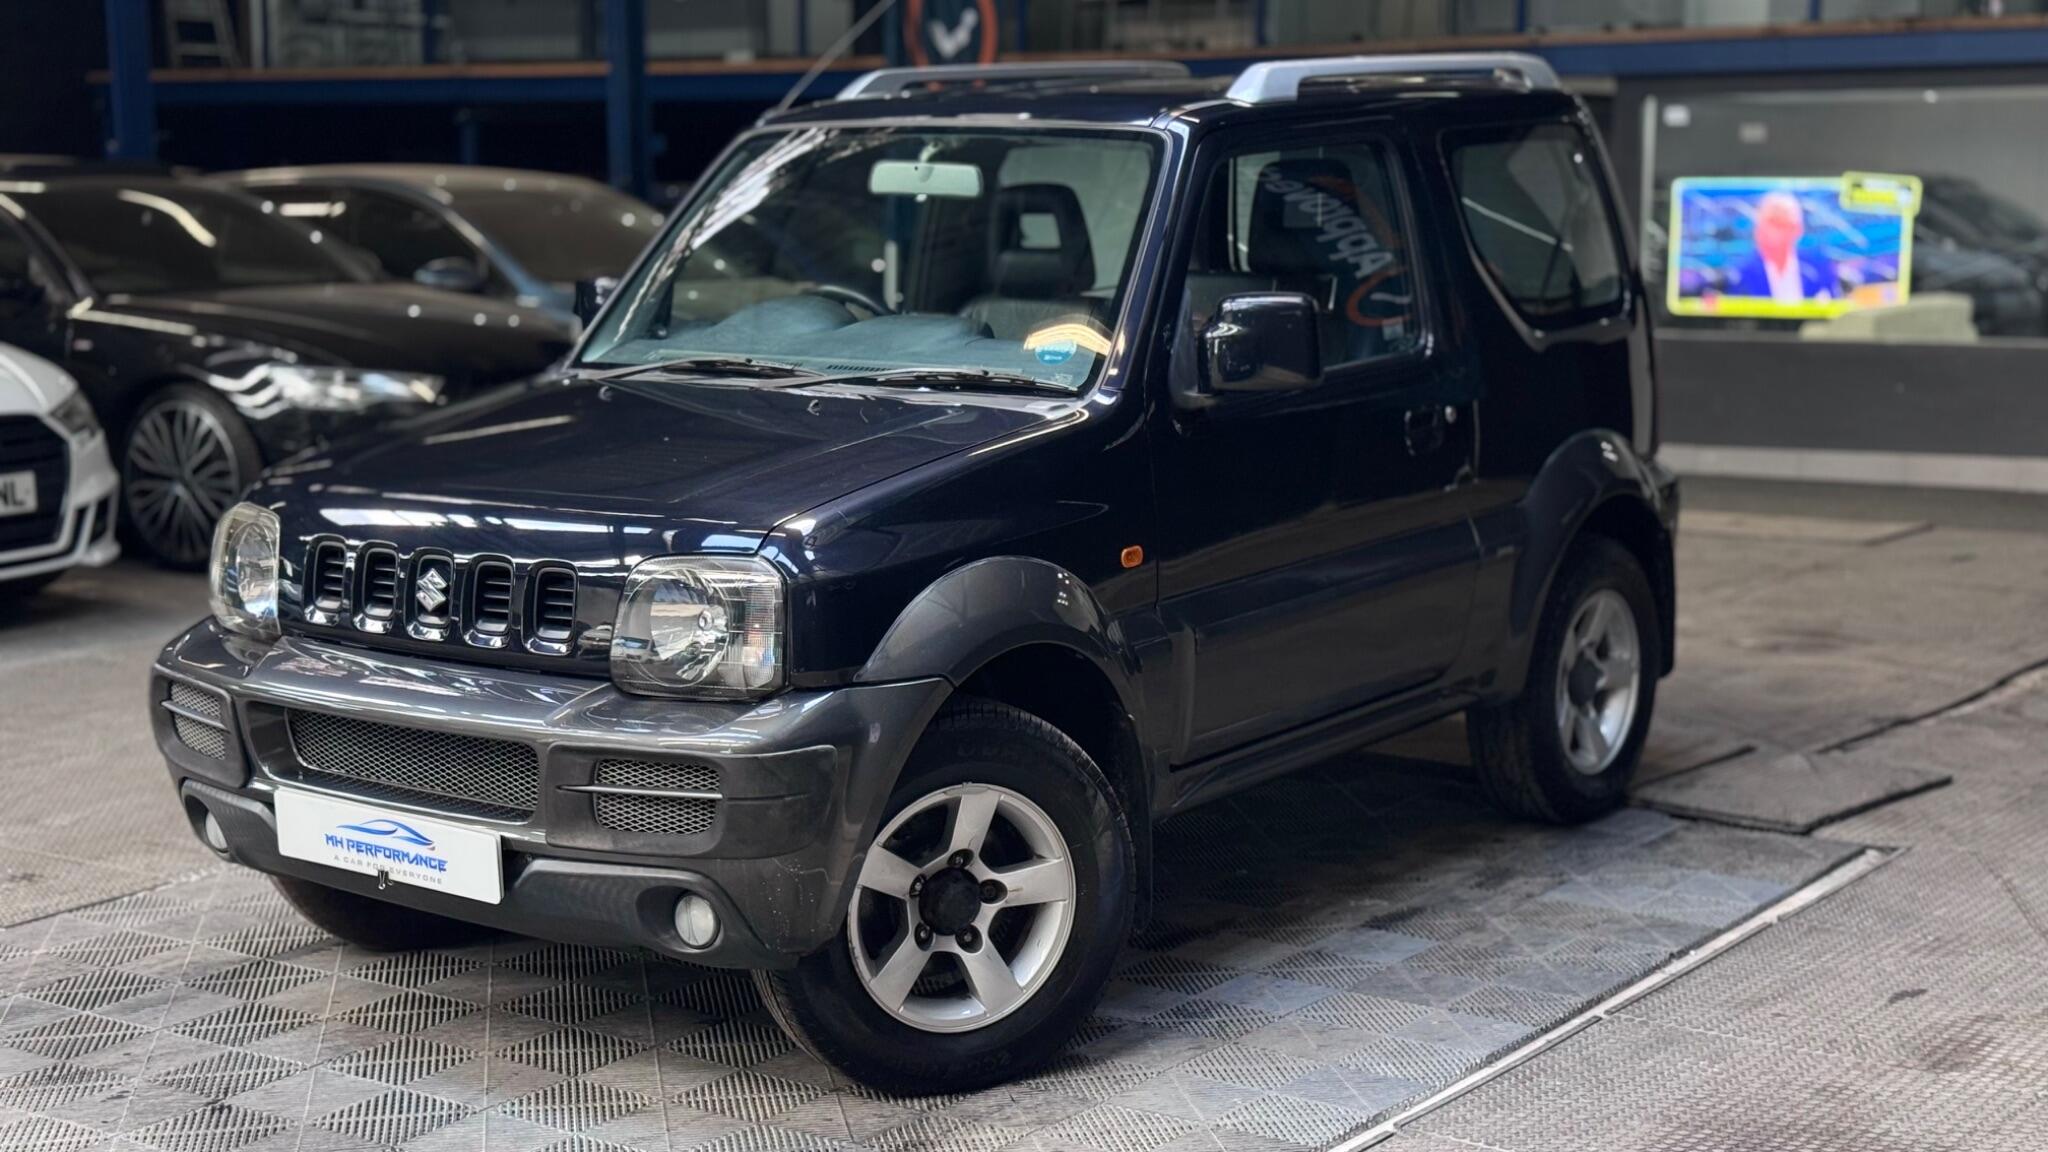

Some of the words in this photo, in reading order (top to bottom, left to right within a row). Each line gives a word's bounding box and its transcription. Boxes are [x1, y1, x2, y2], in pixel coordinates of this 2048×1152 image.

[325, 833, 344, 849] MH
[346, 838, 448, 873] PERFORMANCE
[343, 856, 363, 866] CAR
[366, 860, 385, 871] FOR
[390, 866, 443, 885] EVERYONE
